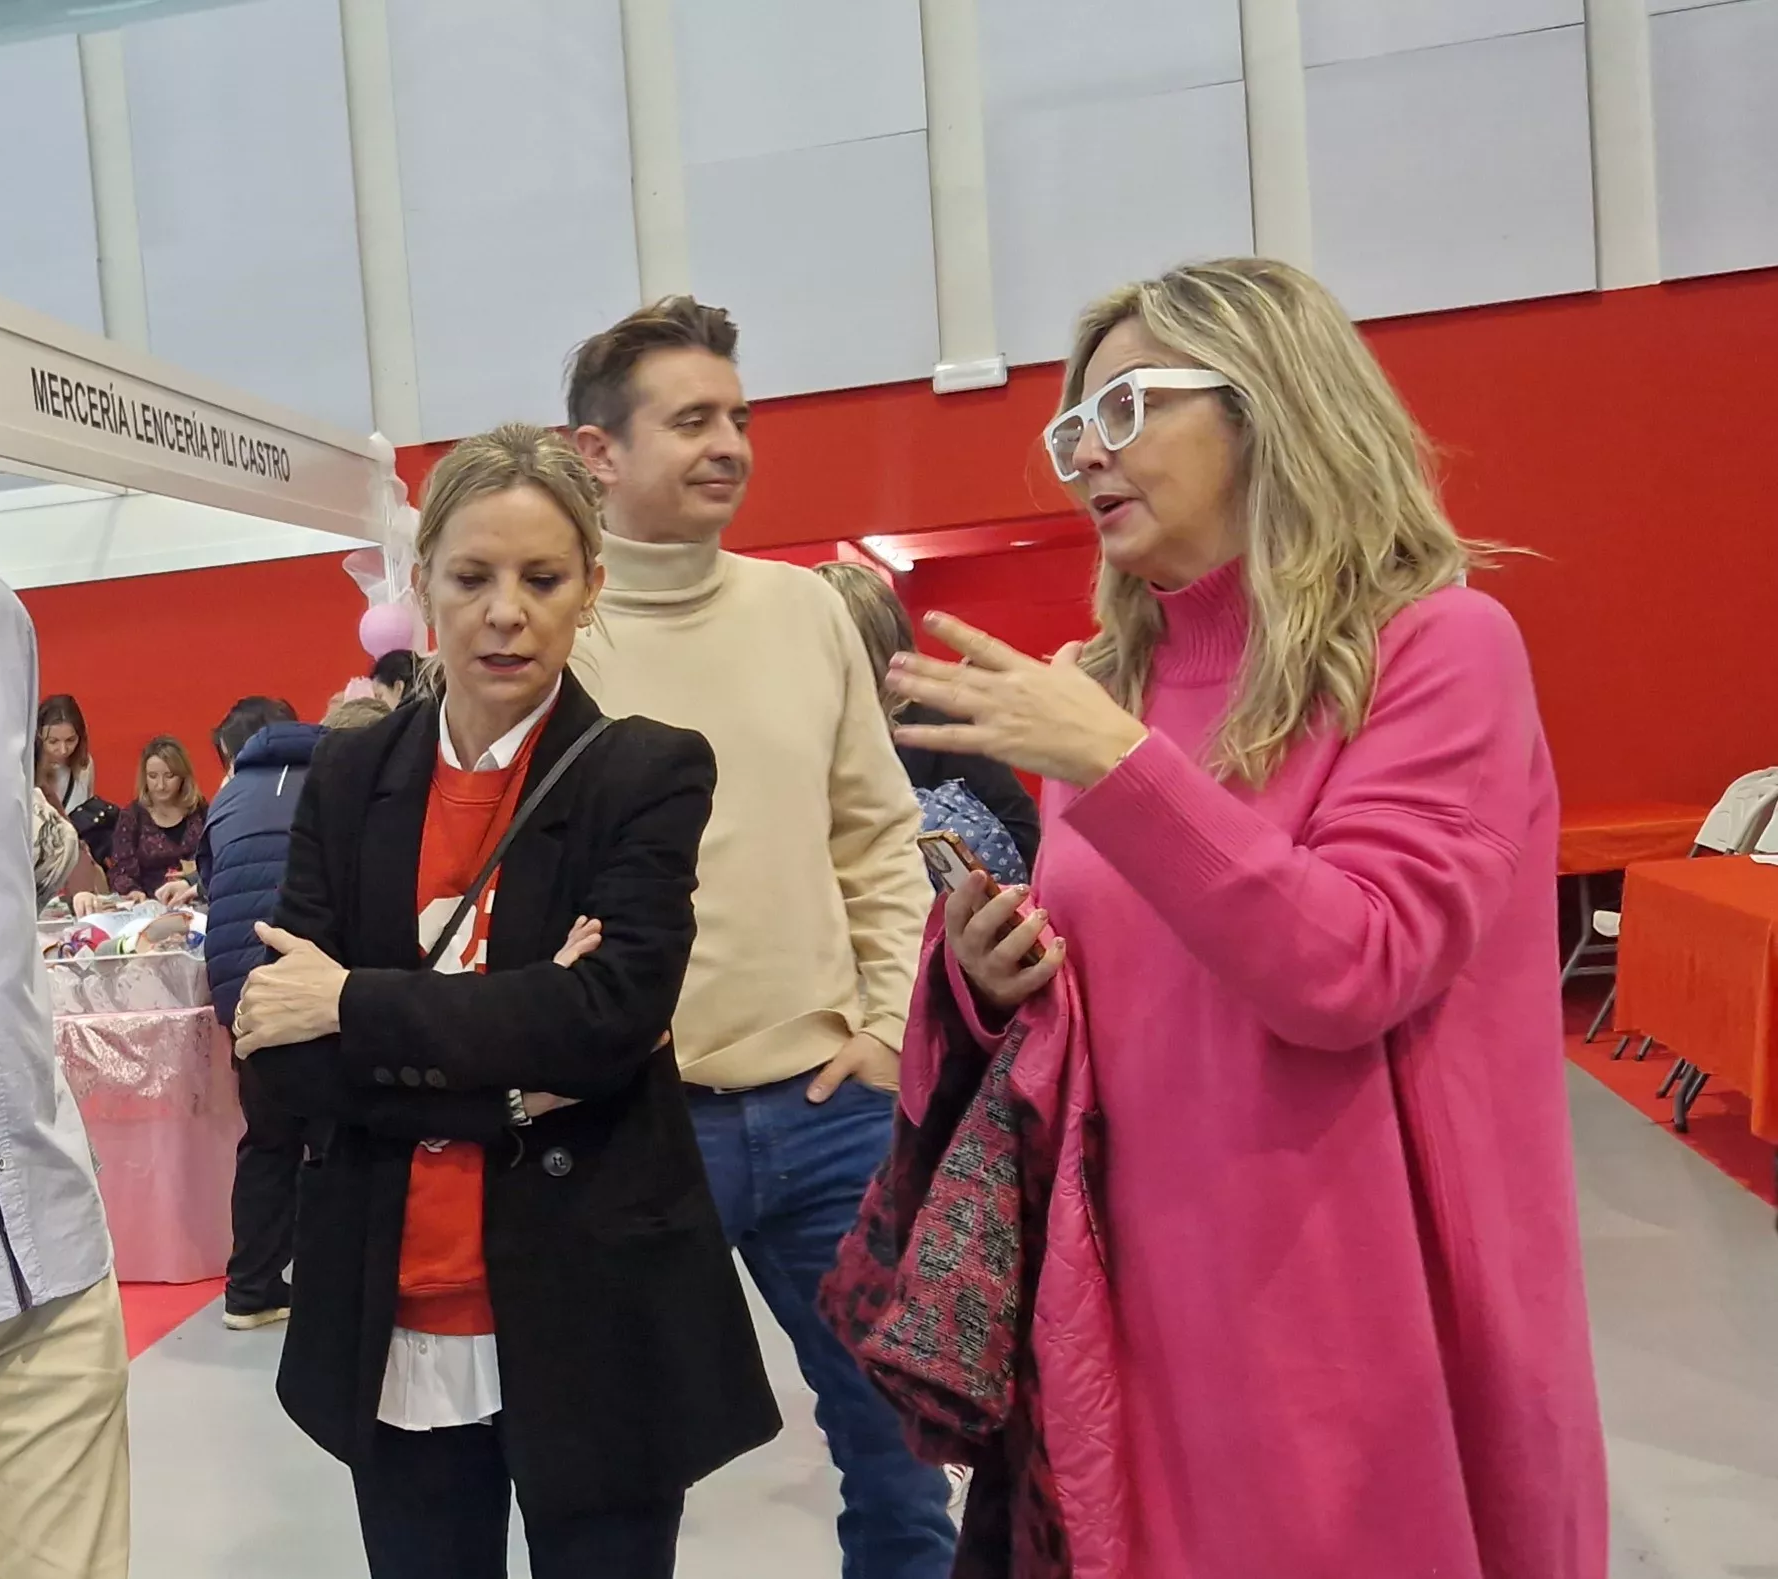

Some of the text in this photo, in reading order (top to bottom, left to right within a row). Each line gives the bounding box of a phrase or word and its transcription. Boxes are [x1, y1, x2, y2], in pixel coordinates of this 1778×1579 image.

[30, 366, 291, 483] MERCERÍA LENCERÍA PILI CASTRO
